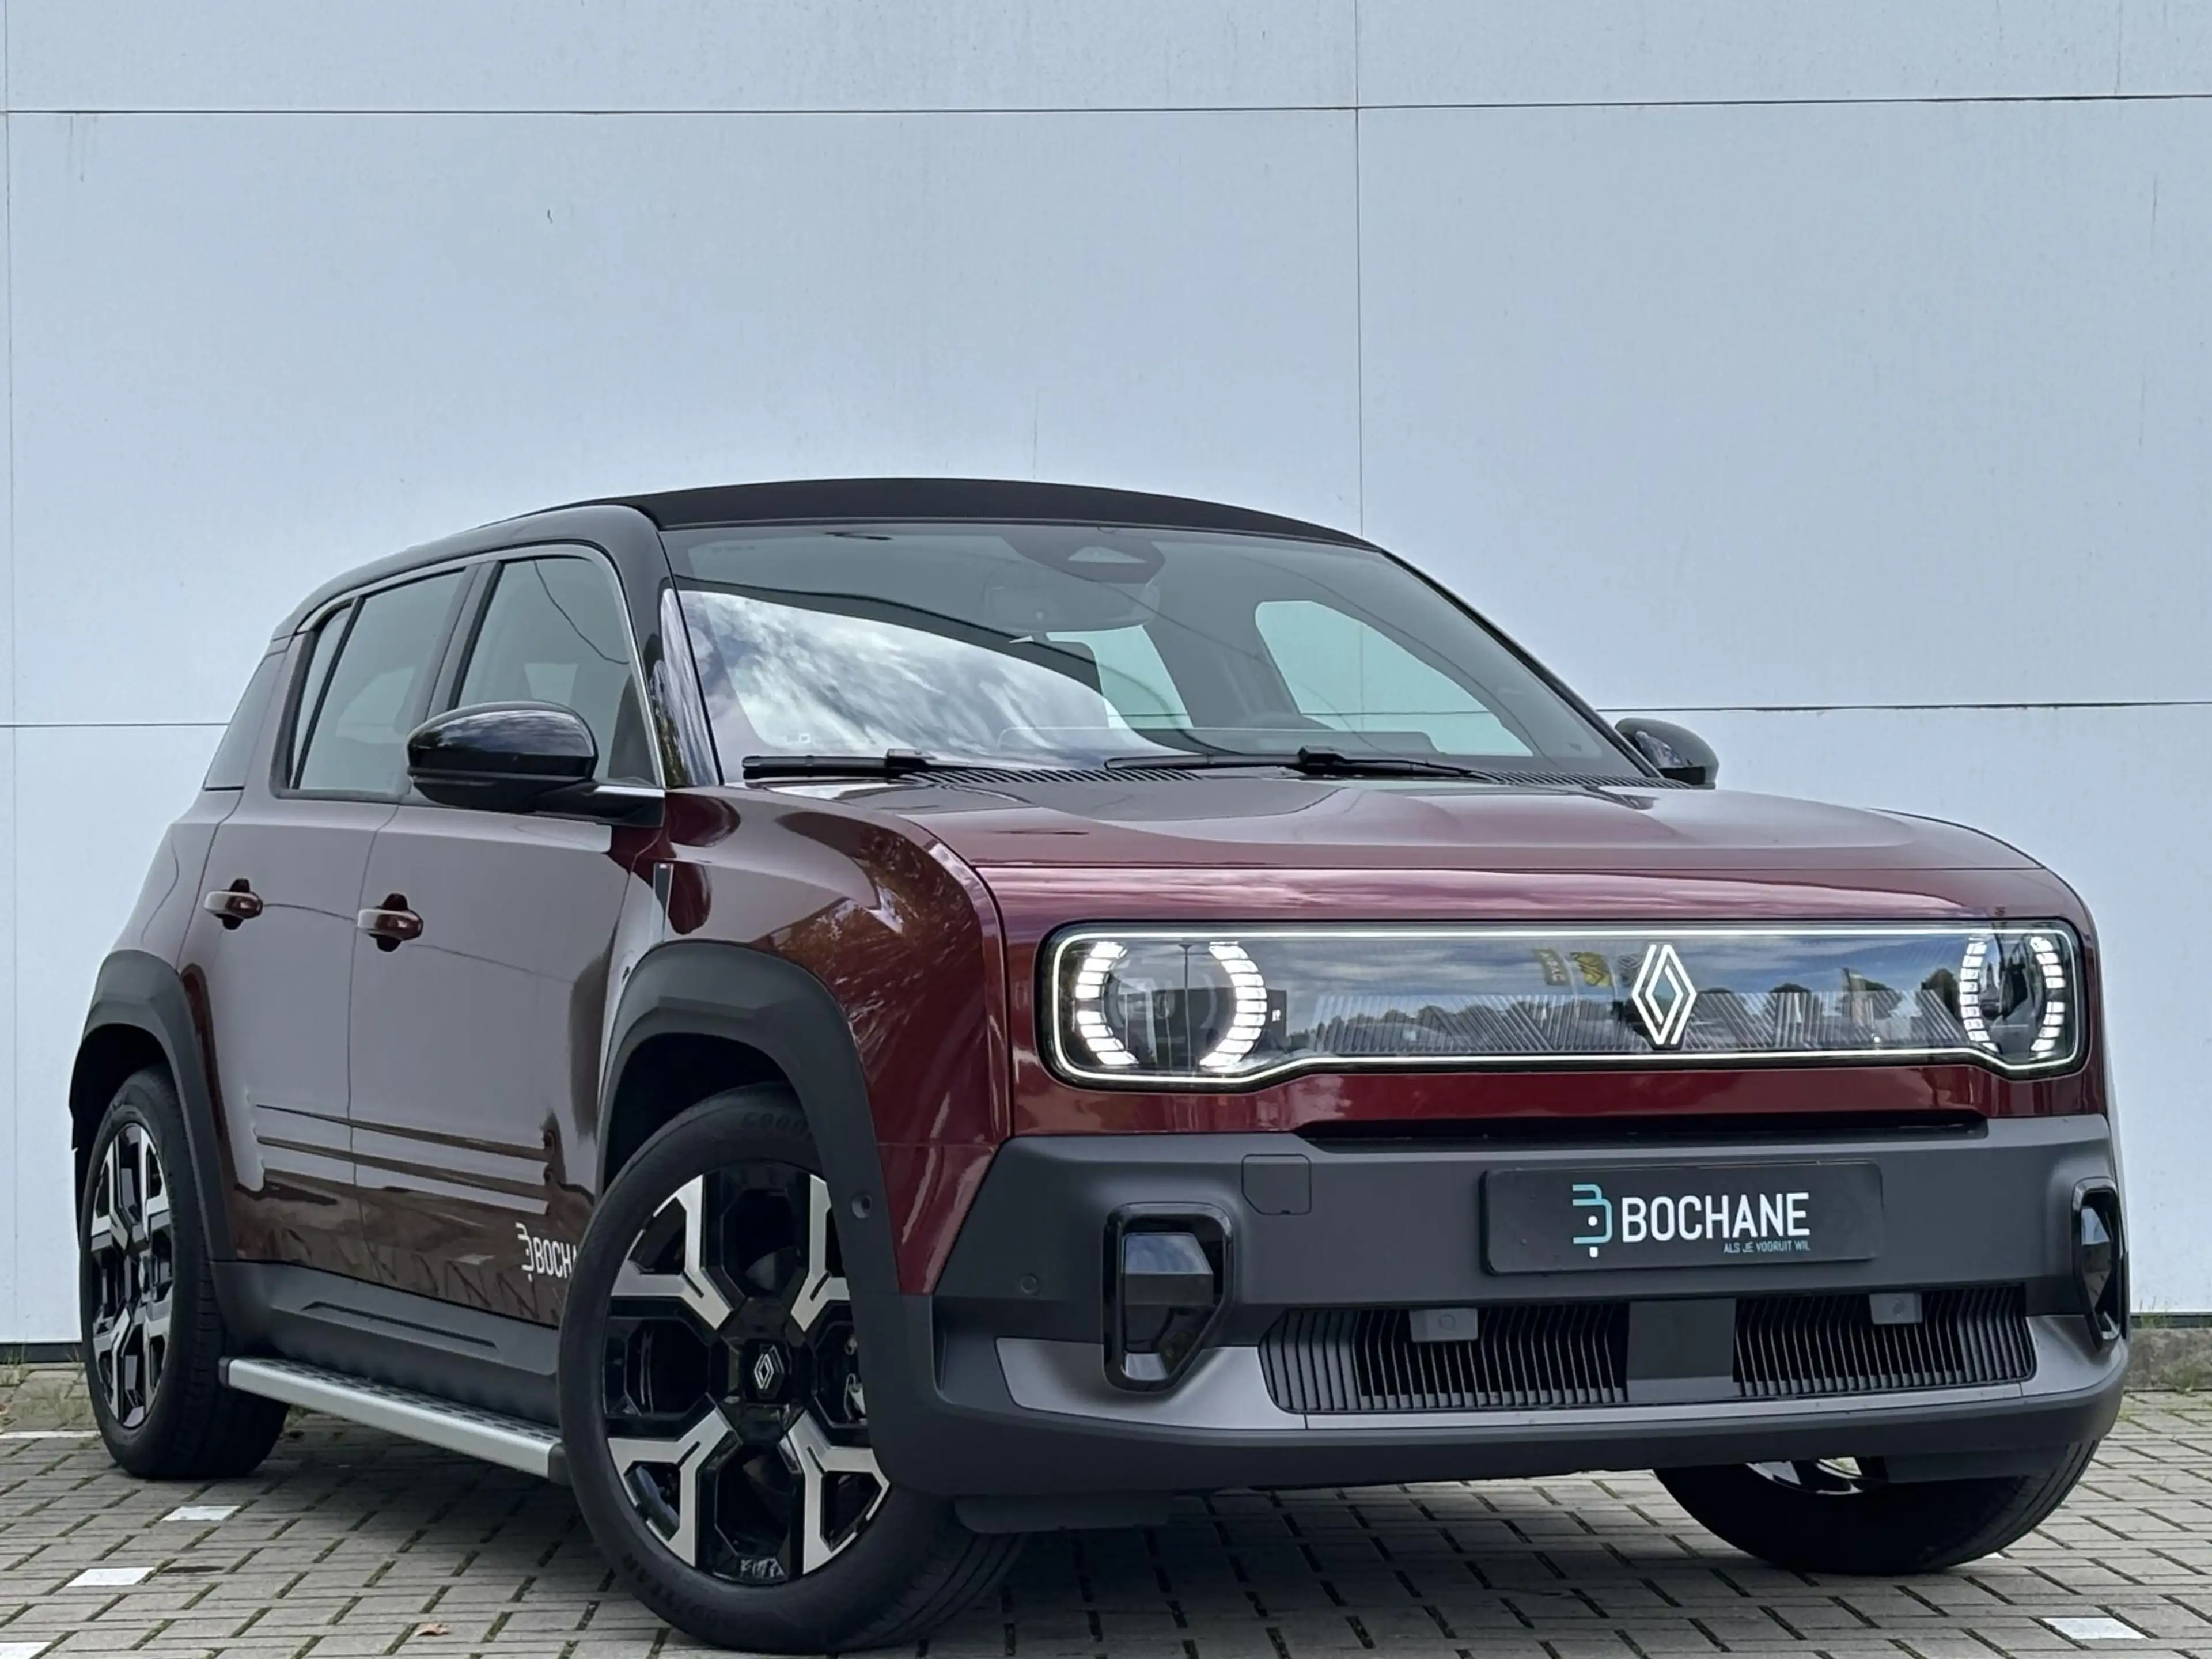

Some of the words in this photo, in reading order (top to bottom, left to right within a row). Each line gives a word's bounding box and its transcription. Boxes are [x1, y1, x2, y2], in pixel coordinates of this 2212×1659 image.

[1622, 1192, 1810, 1243] BOCHANE
[1723, 1242, 1740, 1253] ALS
[1743, 1241, 1755, 1253] JE
[1756, 1240, 1792, 1252] VOORUIT
[1794, 1239, 1810, 1251] WIL
